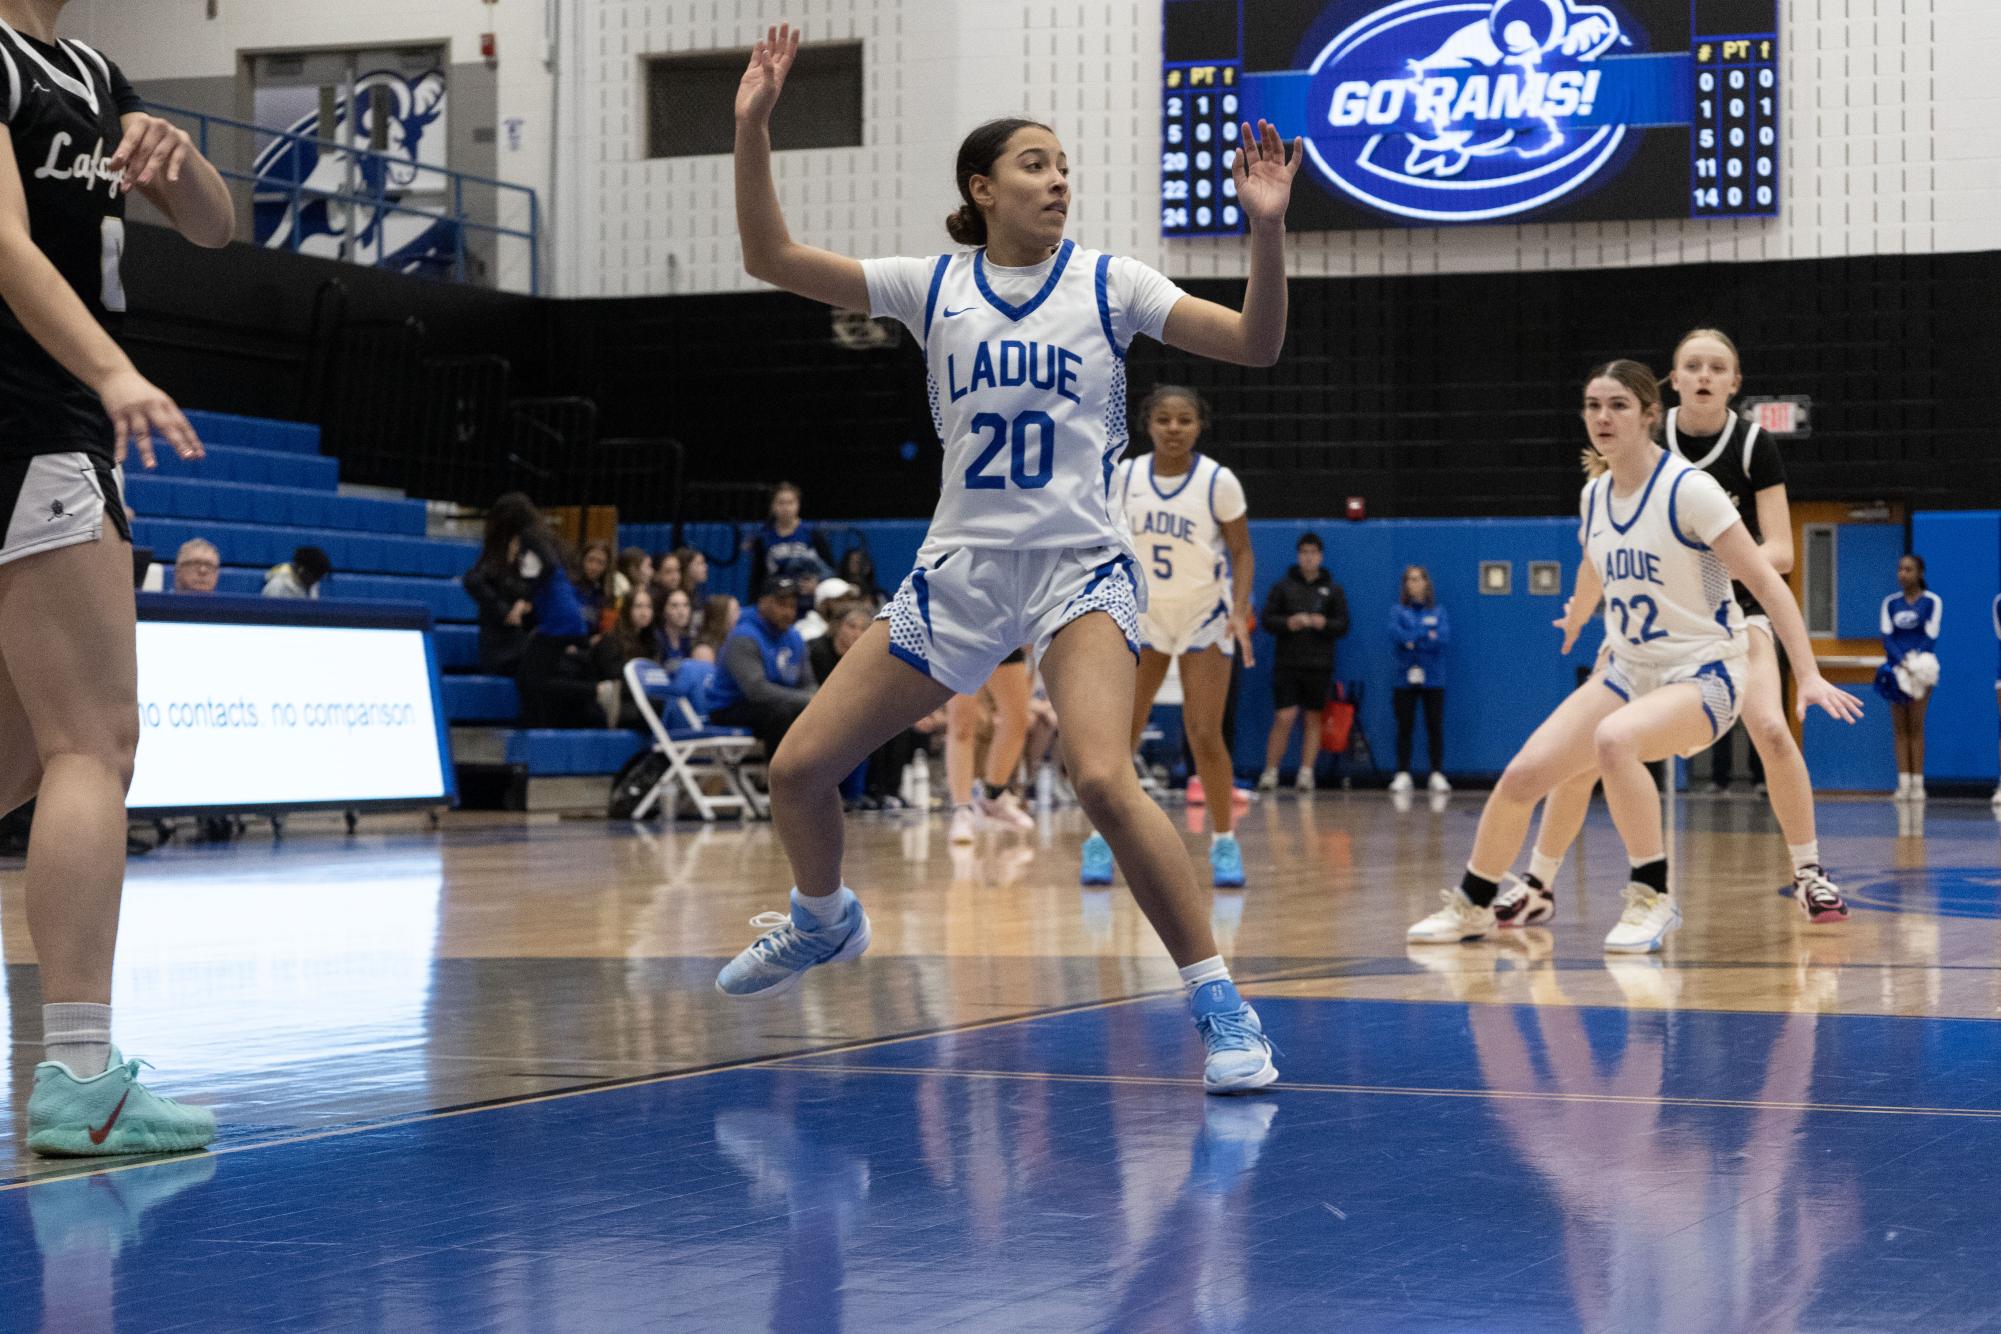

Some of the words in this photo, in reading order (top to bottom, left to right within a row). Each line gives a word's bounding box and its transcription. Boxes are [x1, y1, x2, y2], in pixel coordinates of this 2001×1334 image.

[1722, 40, 1750, 59] PT
[1190, 66, 1217, 86] PT
[1699, 72, 1714, 92] 0
[1729, 70, 1744, 89] 0
[1759, 69, 1774, 88] 0
[1167, 97, 1183, 116] 2
[1197, 96, 1209, 115] 1
[1222, 94, 1238, 114] 0
[1328, 79, 1407, 126] GO
[1414, 70, 1601, 122] RAMS!
[1700, 100, 1712, 119] 1
[1729, 98, 1744, 118] 0
[1760, 97, 1771, 116] 1
[1167, 124, 1182, 144] 5
[1196, 122, 1211, 142] 0
[1222, 122, 1238, 141] 0
[1699, 129, 1714, 148] 5
[1729, 127, 1744, 147] 0
[1759, 126, 1774, 146] 0
[1196, 151, 1212, 170] 0
[1222, 150, 1237, 170] 0
[1695, 158, 1717, 177] 11
[1727, 158, 1742, 177] 0
[1757, 156, 1772, 176] 0
[1163, 180, 1188, 200] 22
[1196, 179, 1212, 198] 0
[1222, 178, 1238, 197] 0
[1694, 188, 1719, 207] 14
[1727, 187, 1742, 206] 0
[1757, 185, 1772, 205] 0
[1163, 208, 1188, 227] 24
[1196, 206, 1212, 226] 0
[1222, 205, 1238, 225] 0
[947, 340, 1082, 405] LADUE
[965, 410, 1055, 489] 20
[1131, 511, 1196, 545] LADUE
[1152, 544, 1173, 580] 5
[1603, 548, 1664, 588] ADUE
[1611, 594, 1670, 645] 22
[272, 702, 297, 728] no
